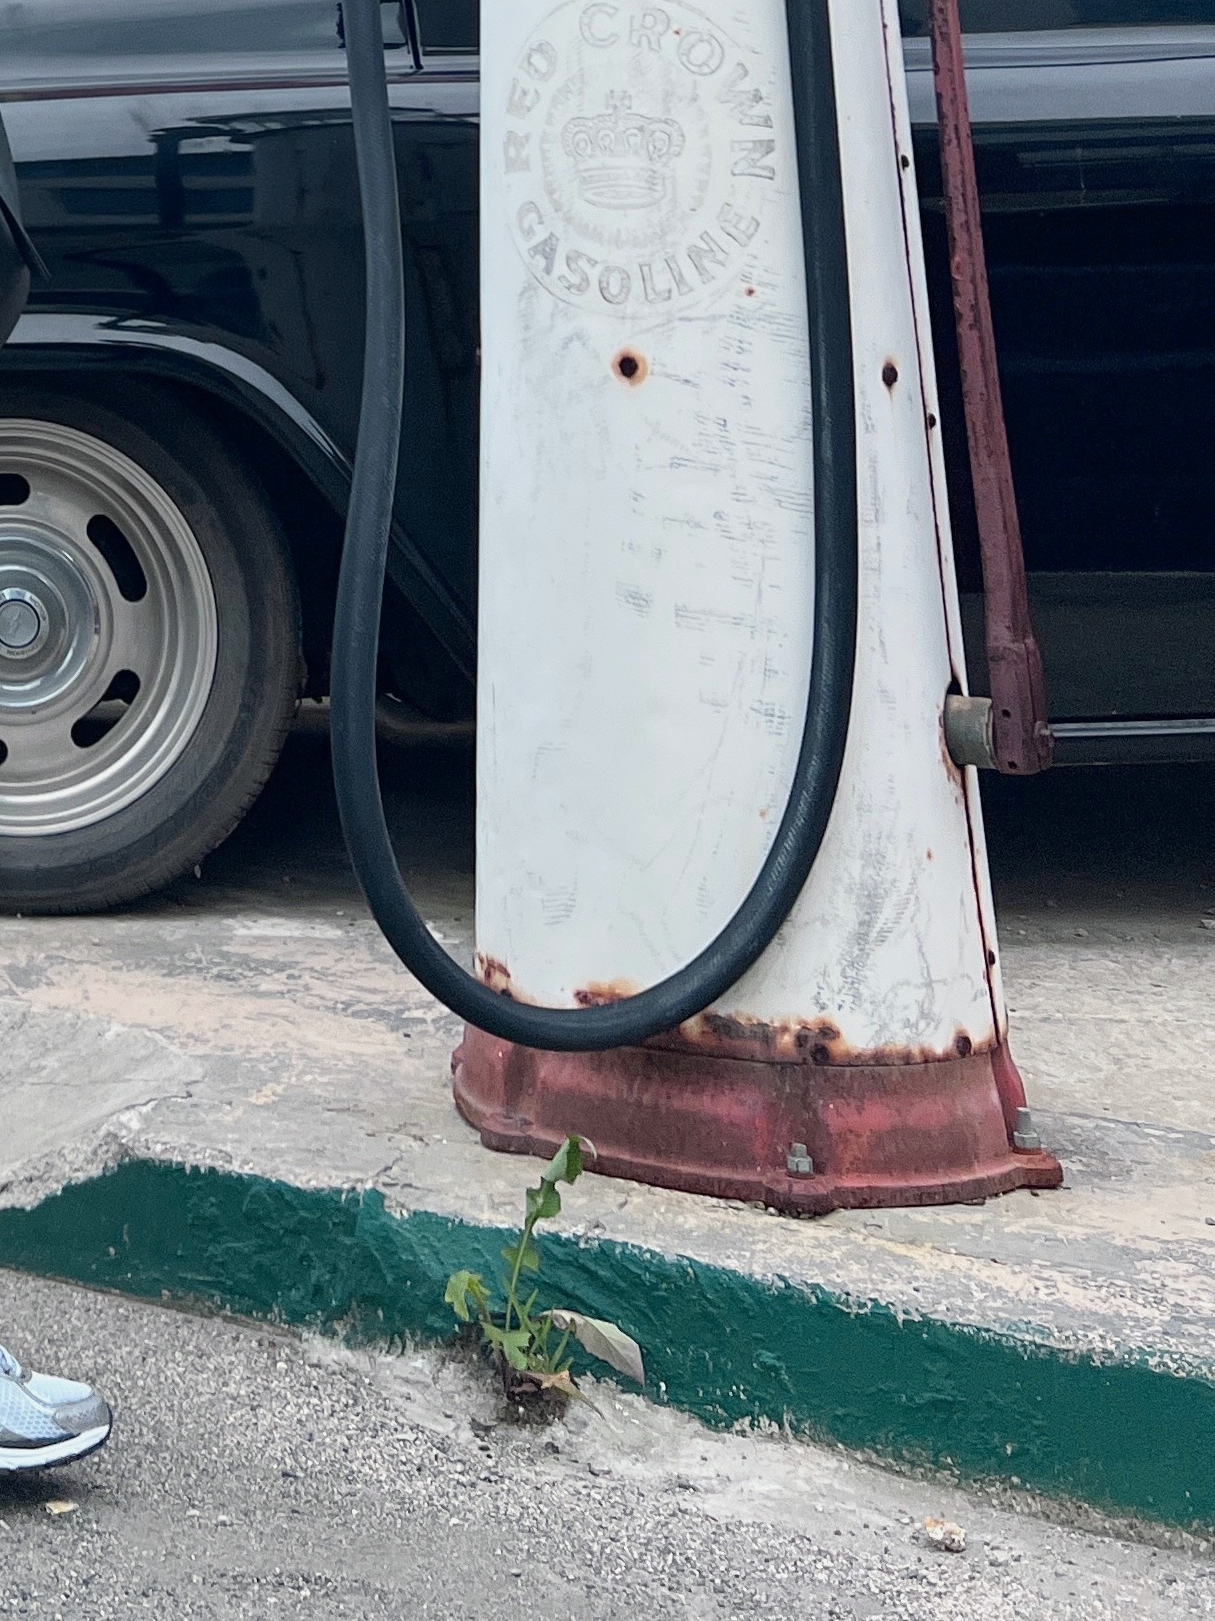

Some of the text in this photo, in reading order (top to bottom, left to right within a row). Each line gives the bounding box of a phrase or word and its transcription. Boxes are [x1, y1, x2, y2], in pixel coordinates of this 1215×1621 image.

[503, 2, 776, 181] RED CROWN
[516, 200, 761, 306] GASOLINE
